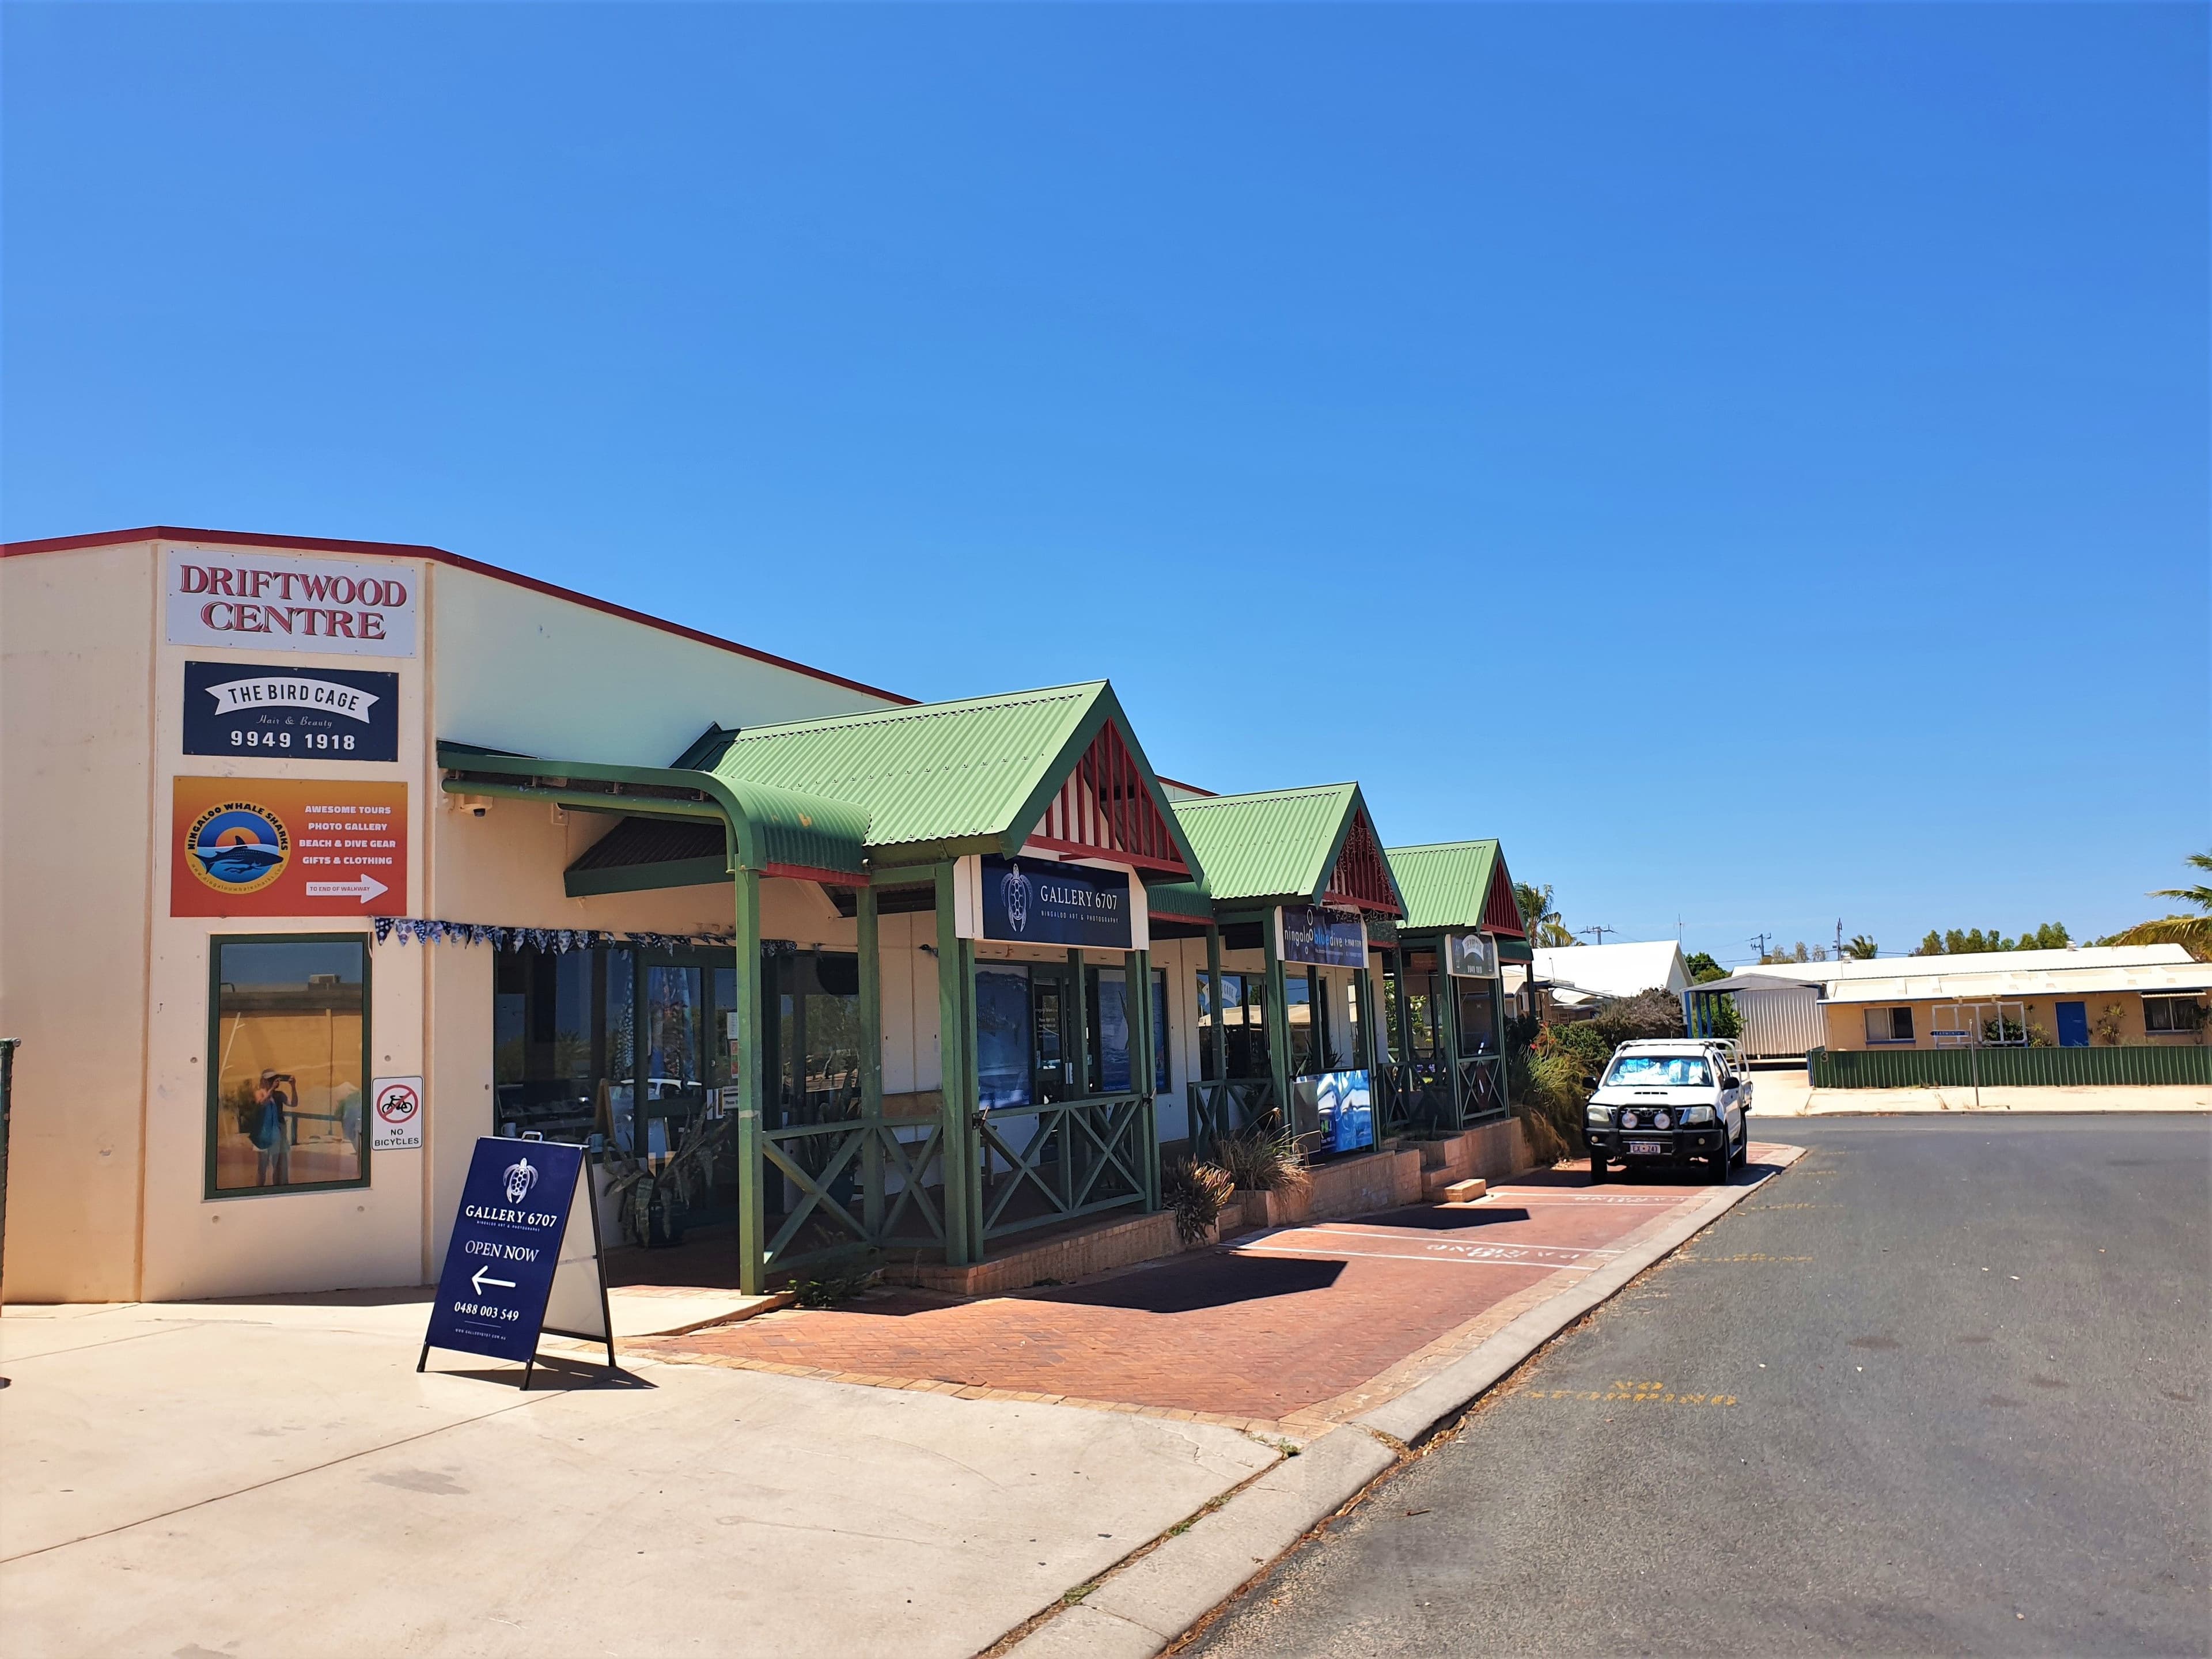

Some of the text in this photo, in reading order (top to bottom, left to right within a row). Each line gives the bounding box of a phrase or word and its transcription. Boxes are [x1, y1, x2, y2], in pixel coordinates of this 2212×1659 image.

[180, 565, 407, 607] DRIFTWOOD
[200, 601, 387, 639] CENTRE
[228, 684, 360, 711] THE BIRD CAGE
[256, 715, 333, 728] Hair & Beauty
[230, 730, 355, 750] 9949 1918
[305, 805, 357, 814] AWESOME
[188, 802, 288, 851] NINGALOO WHALE SHARKS
[299, 839, 332, 847] BEACH
[343, 857, 392, 865] CLOTHING
[1040, 885, 1117, 910] GALLERY 6707
[1041, 910, 1066, 919] NINGALOO
[374, 1137, 419, 1146] BICYCLES
[465, 1205, 557, 1227] GALLERY 6707
[465, 1240, 539, 1262] OPEN NOW
[454, 1301, 519, 1321] 0488 003 549
